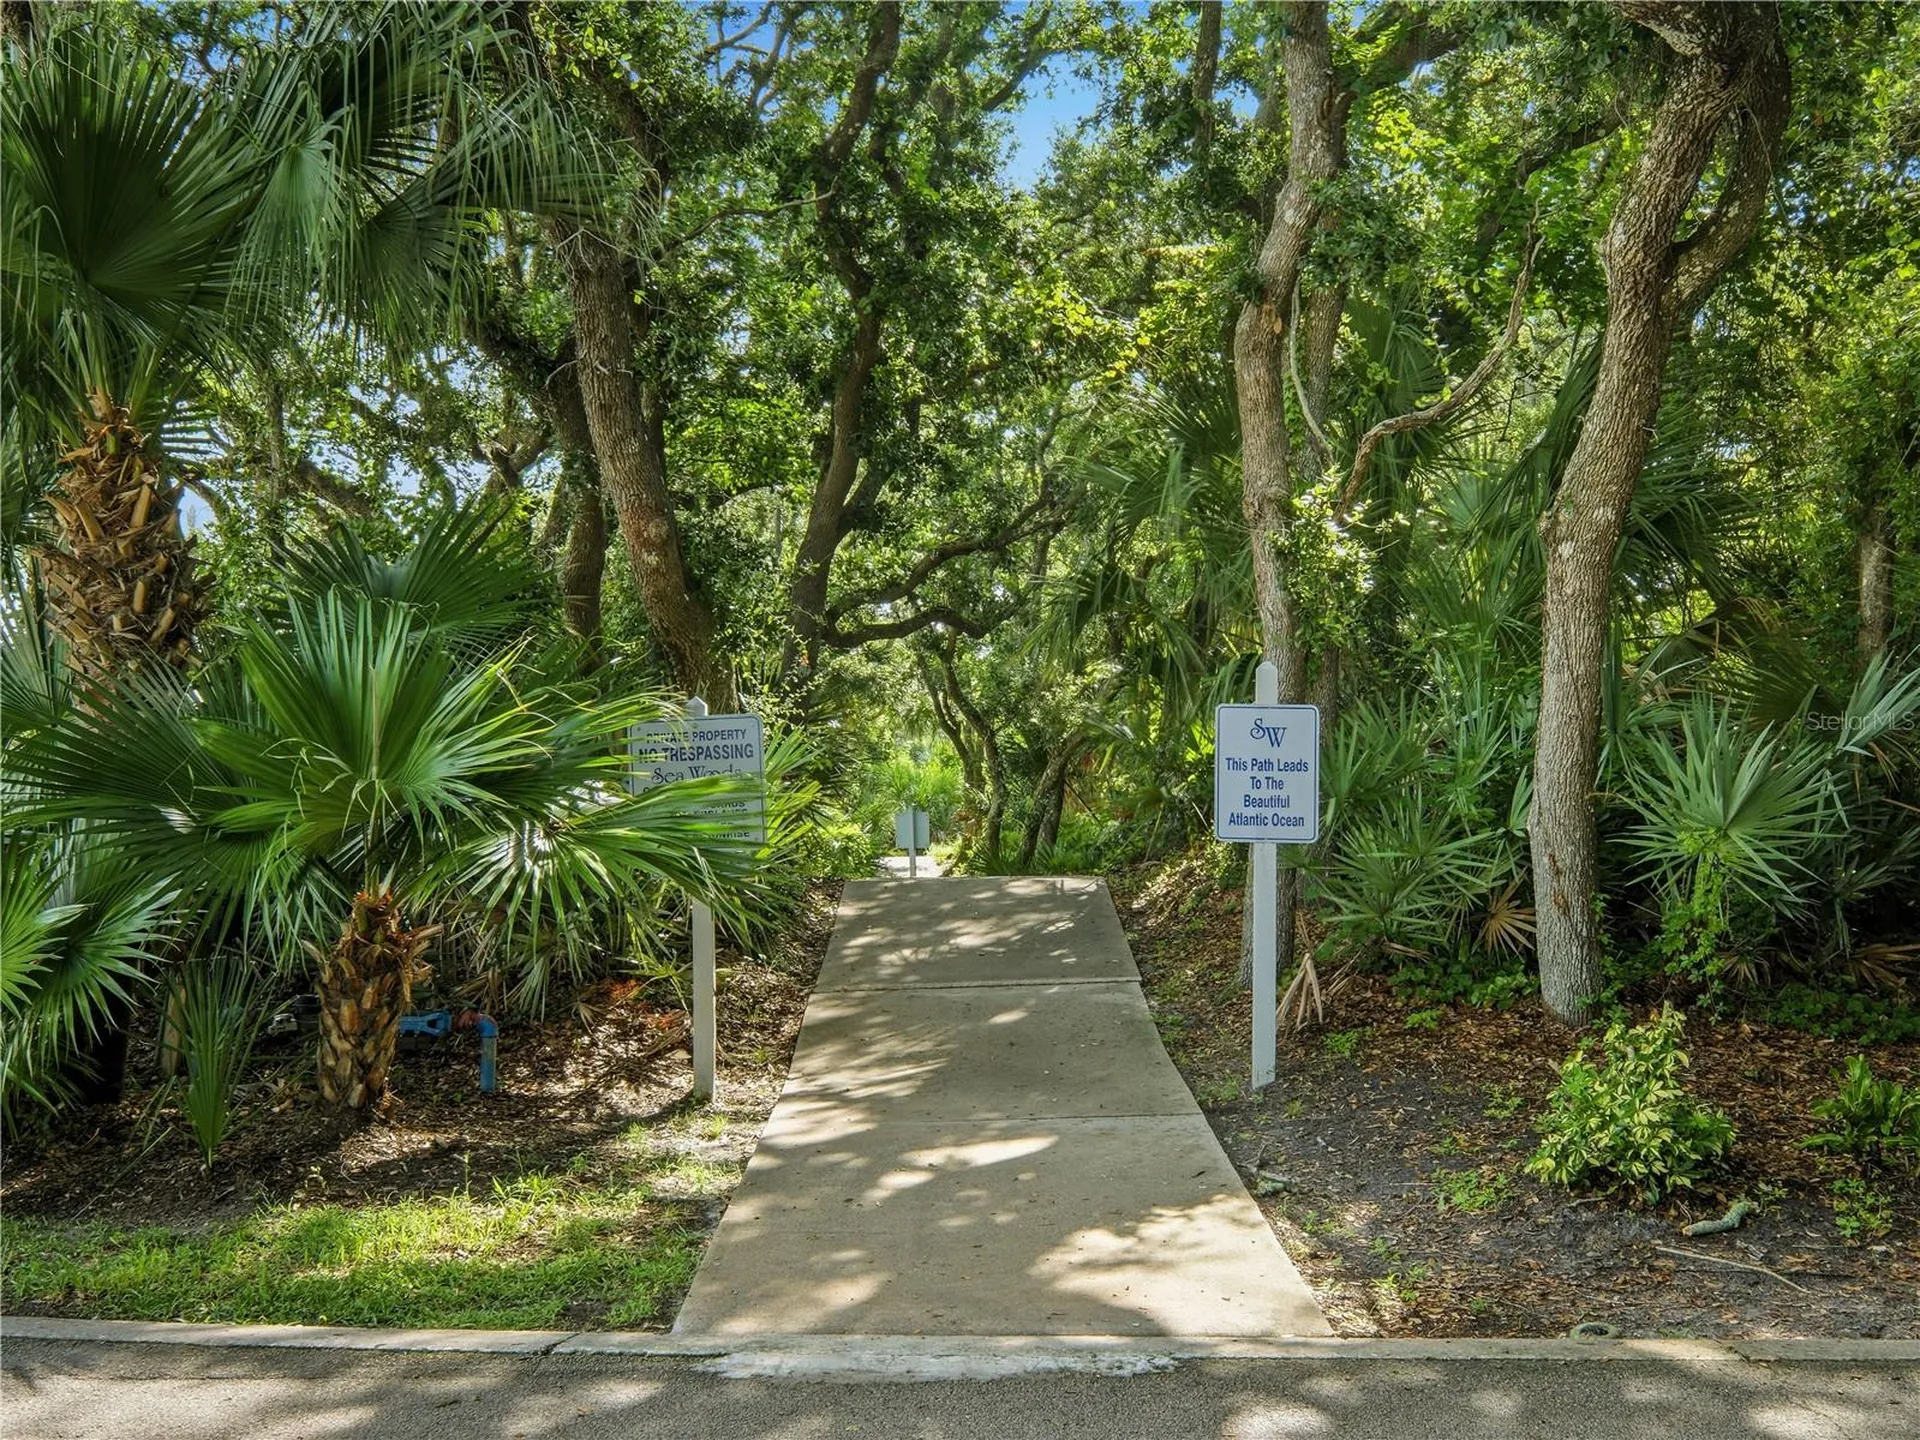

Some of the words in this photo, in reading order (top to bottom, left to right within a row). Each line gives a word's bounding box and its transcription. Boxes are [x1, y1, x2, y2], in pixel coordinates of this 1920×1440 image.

[692, 729, 747, 741] PROPERTY
[661, 743, 754, 762] TRESPASSING
[1225, 757, 1248, 772] This
[1251, 758, 1274, 772] Path
[1277, 758, 1309, 772] Leads
[651, 767, 684, 784] Sea
[1250, 776, 1262, 790] To
[1265, 776, 1284, 790] The
[1243, 794, 1290, 808] Beautiful
[1228, 812, 1269, 827] Atlantic
[1271, 813, 1305, 827] Ocean
